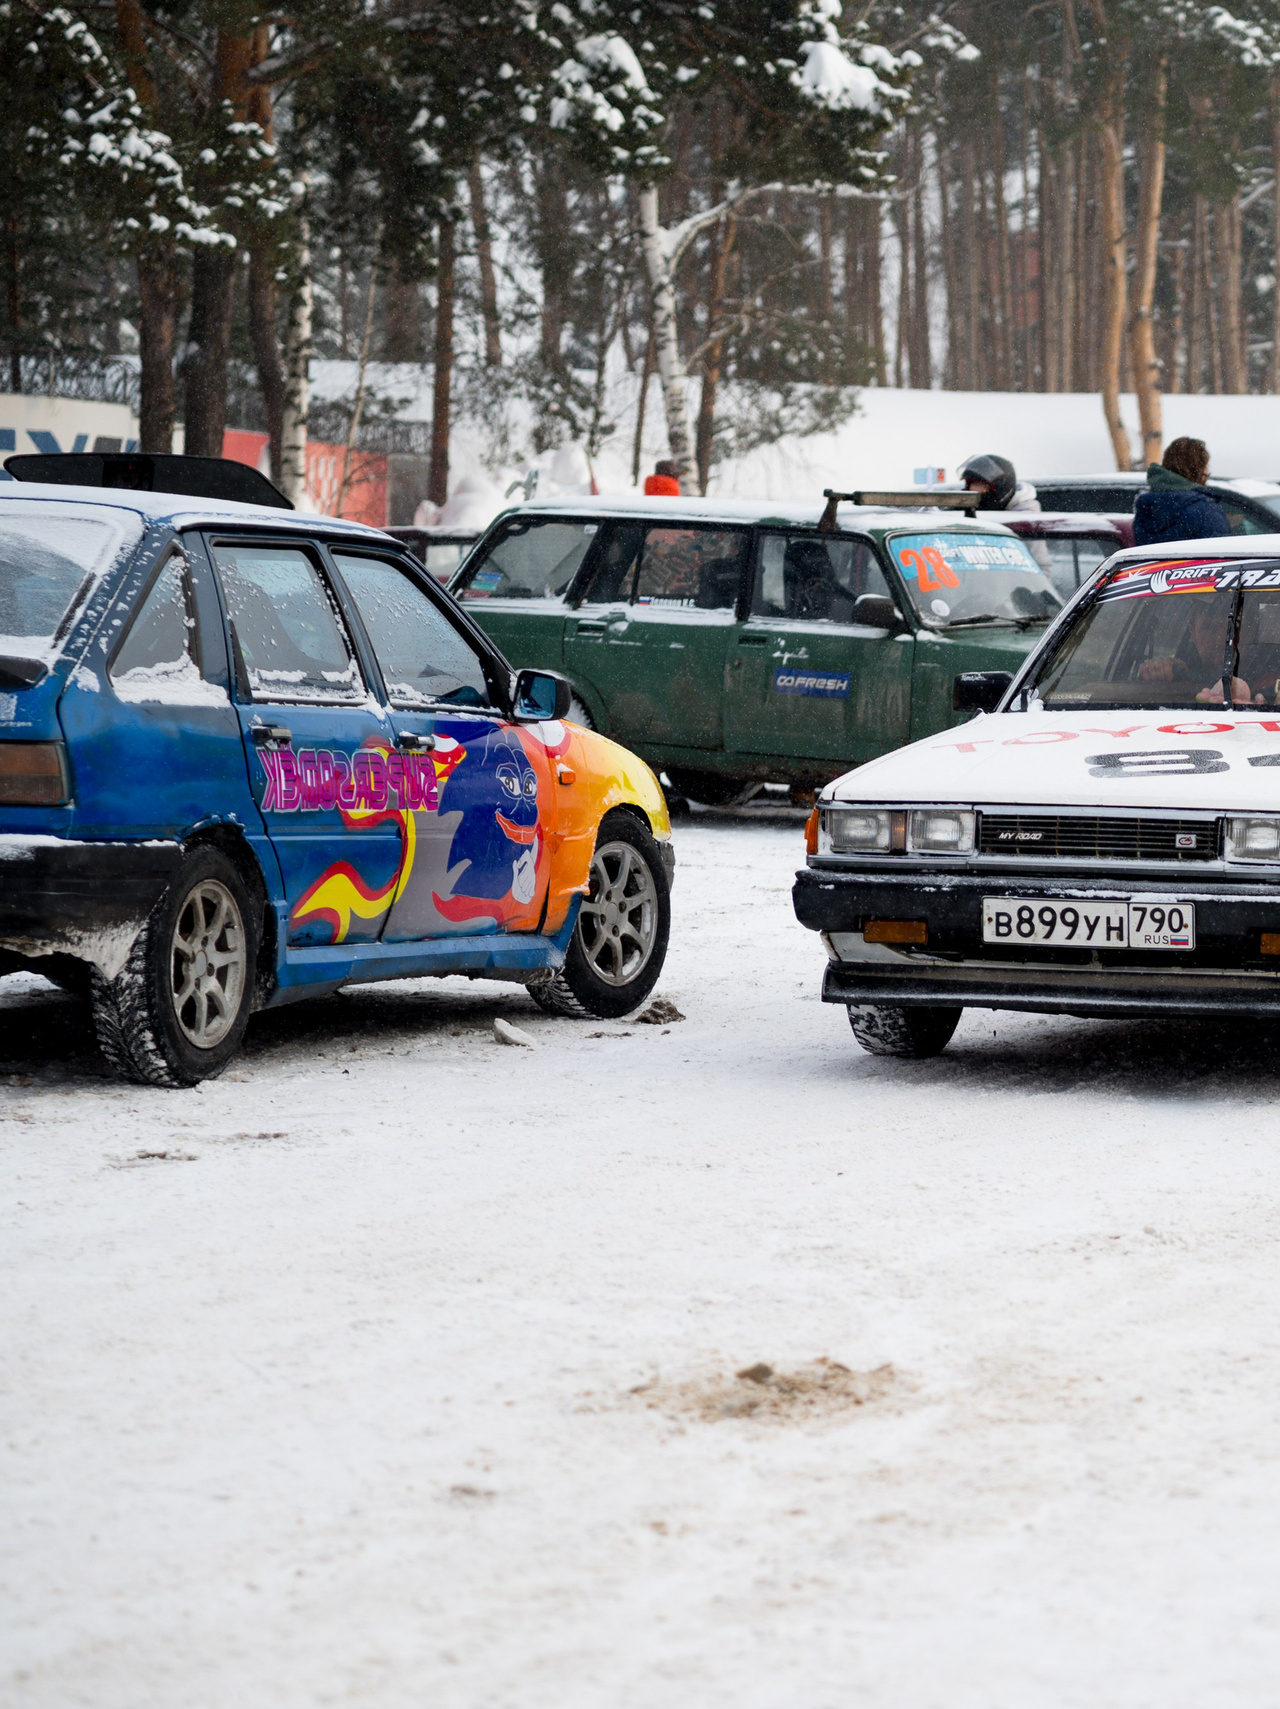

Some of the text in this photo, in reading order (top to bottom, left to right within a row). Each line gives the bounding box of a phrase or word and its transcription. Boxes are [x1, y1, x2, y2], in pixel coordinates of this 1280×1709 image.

[899, 546, 960, 593] 28
[1169, 567, 1222, 580] DRIFT
[795, 676, 848, 691] FRESH
[1015, 832, 1043, 840] ROAD
[1132, 907, 1184, 933] 790
[1144, 934, 1169, 945] RUS
